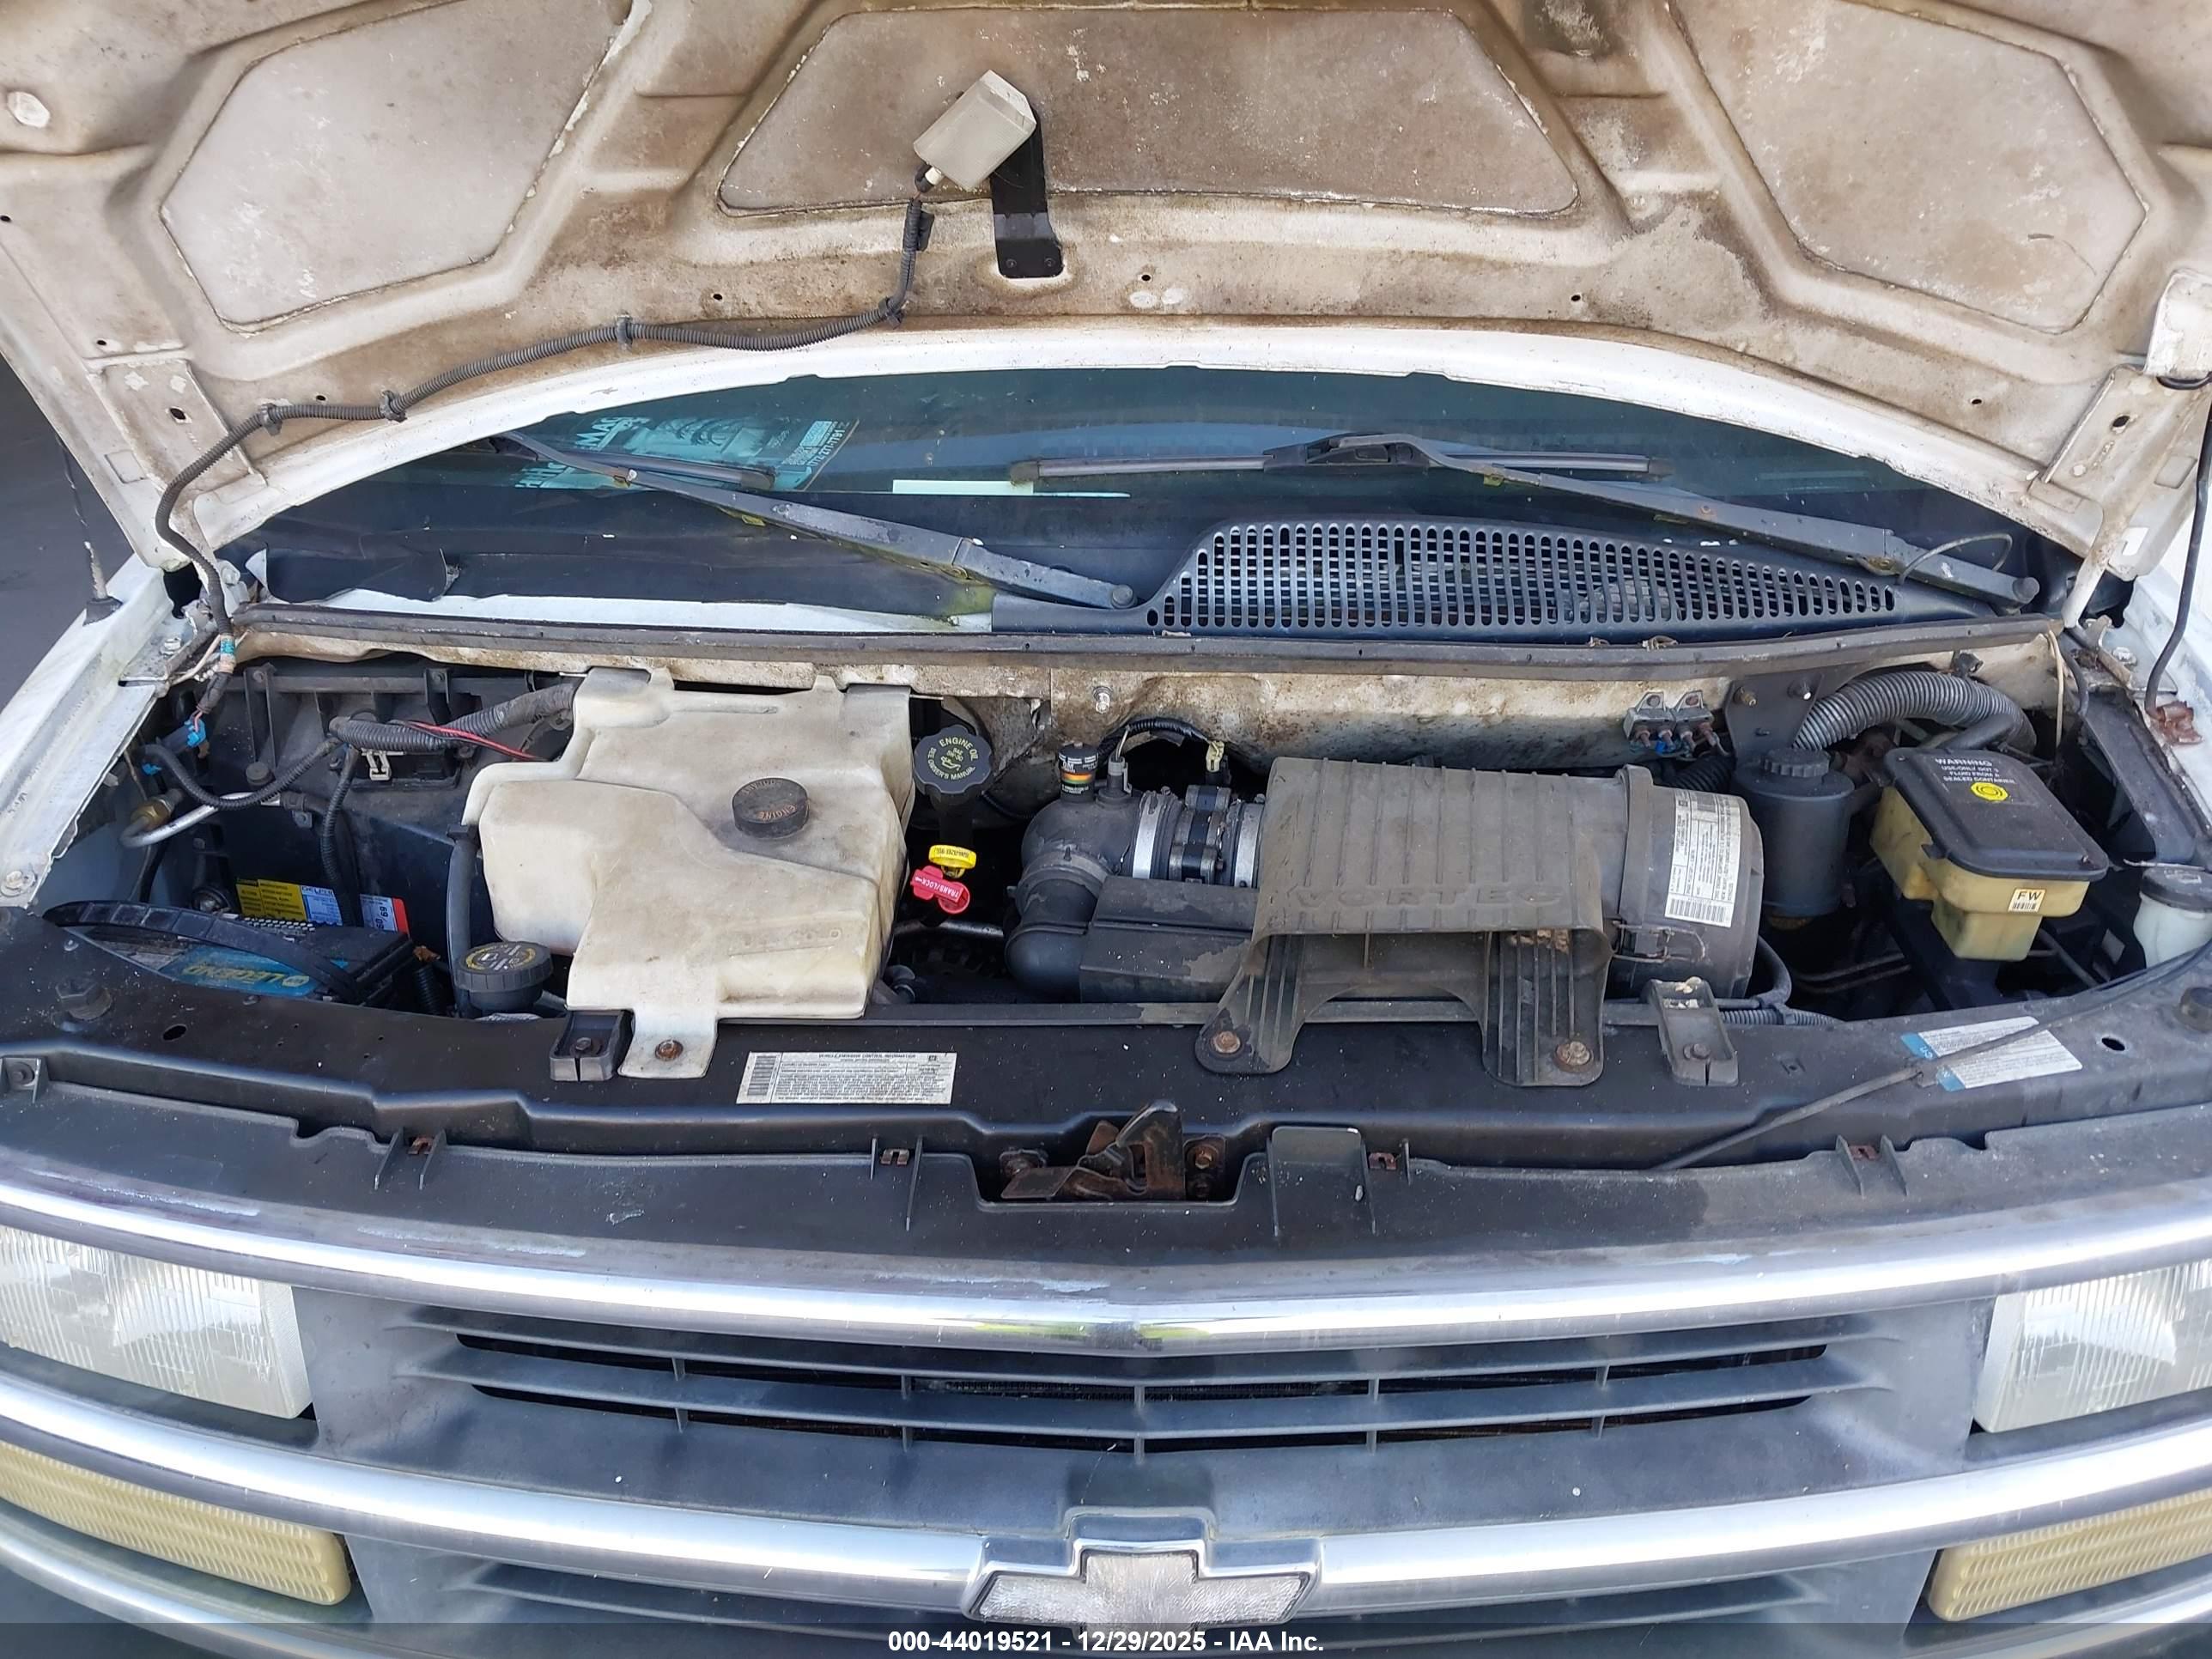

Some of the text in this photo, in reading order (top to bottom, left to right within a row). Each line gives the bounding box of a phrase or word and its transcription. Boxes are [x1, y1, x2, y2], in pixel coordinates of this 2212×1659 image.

[939, 737, 980, 762] ENGINE OIL
[927, 747, 976, 781] SEE OWNER'S MANUAL
[1935, 758, 1993, 767] WARNING
[921, 878, 961, 898] TRANS/LOCK
[1293, 884, 1564, 908] VORTEC
[183, 965, 285, 984] LEGEND
